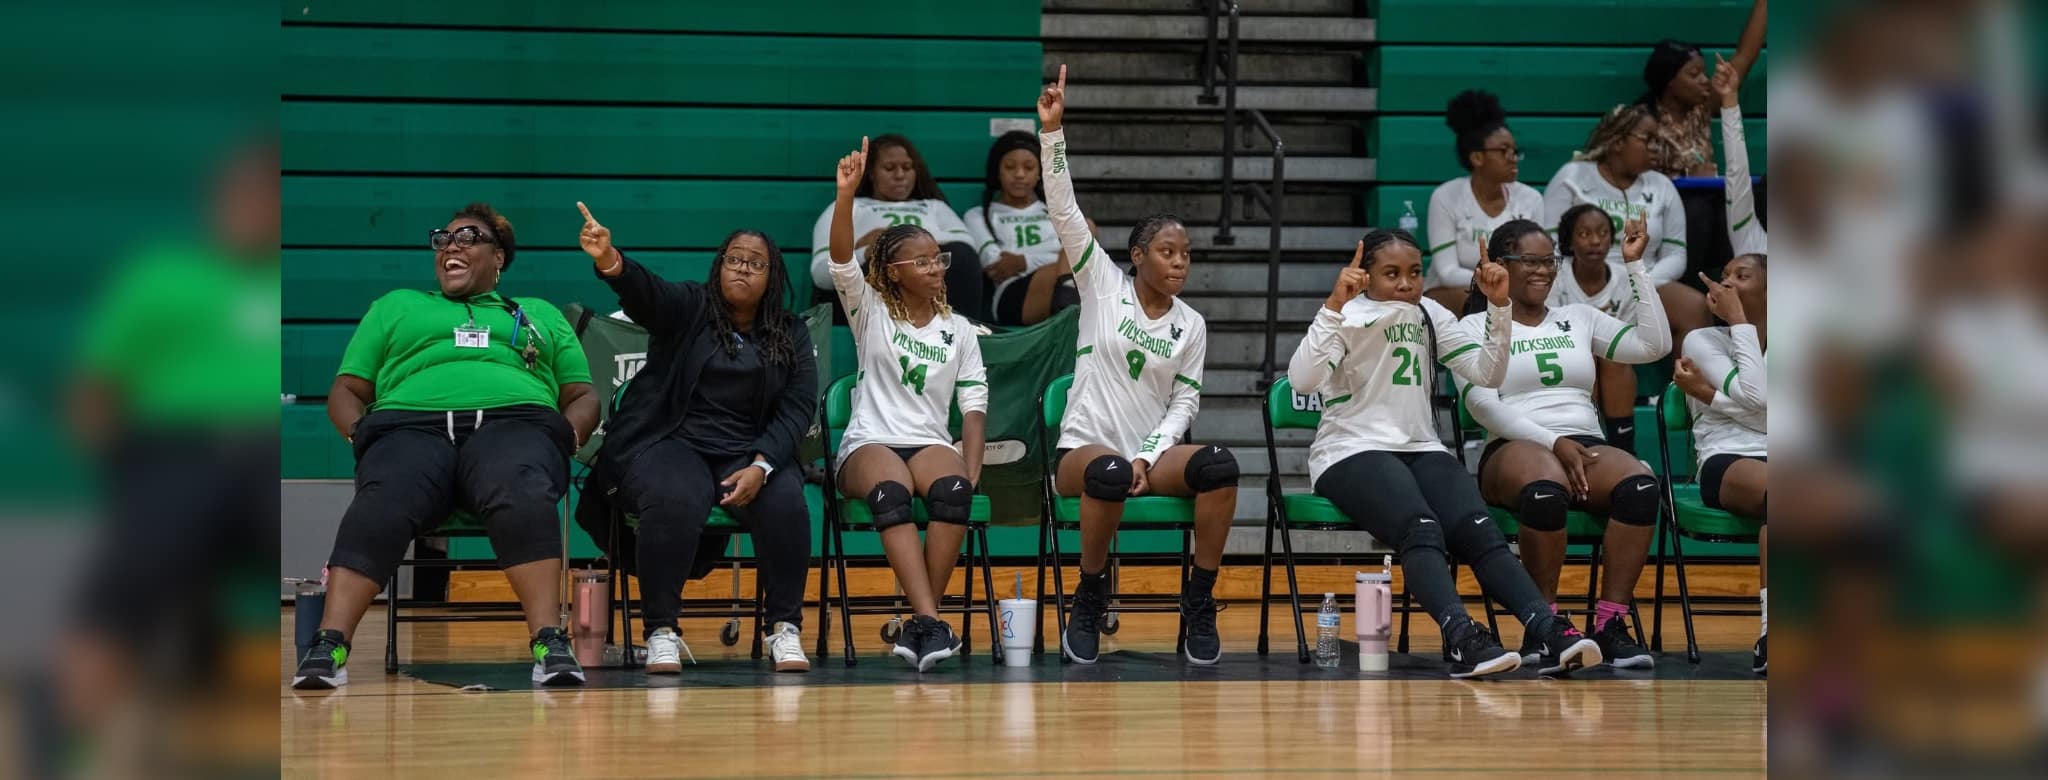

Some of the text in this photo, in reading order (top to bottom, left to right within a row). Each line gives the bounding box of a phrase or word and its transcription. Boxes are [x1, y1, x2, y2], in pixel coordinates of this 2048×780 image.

[1014, 224, 1042, 248] 16
[892, 328, 948, 364] VICKSBURG
[1117, 315, 1173, 359] VICKSBURG
[1510, 335, 1576, 356] VICKSBURG
[899, 355, 928, 396] 14
[1126, 348, 1147, 382] 9
[1392, 346, 1422, 387] 24
[1535, 352, 1564, 387] 5
